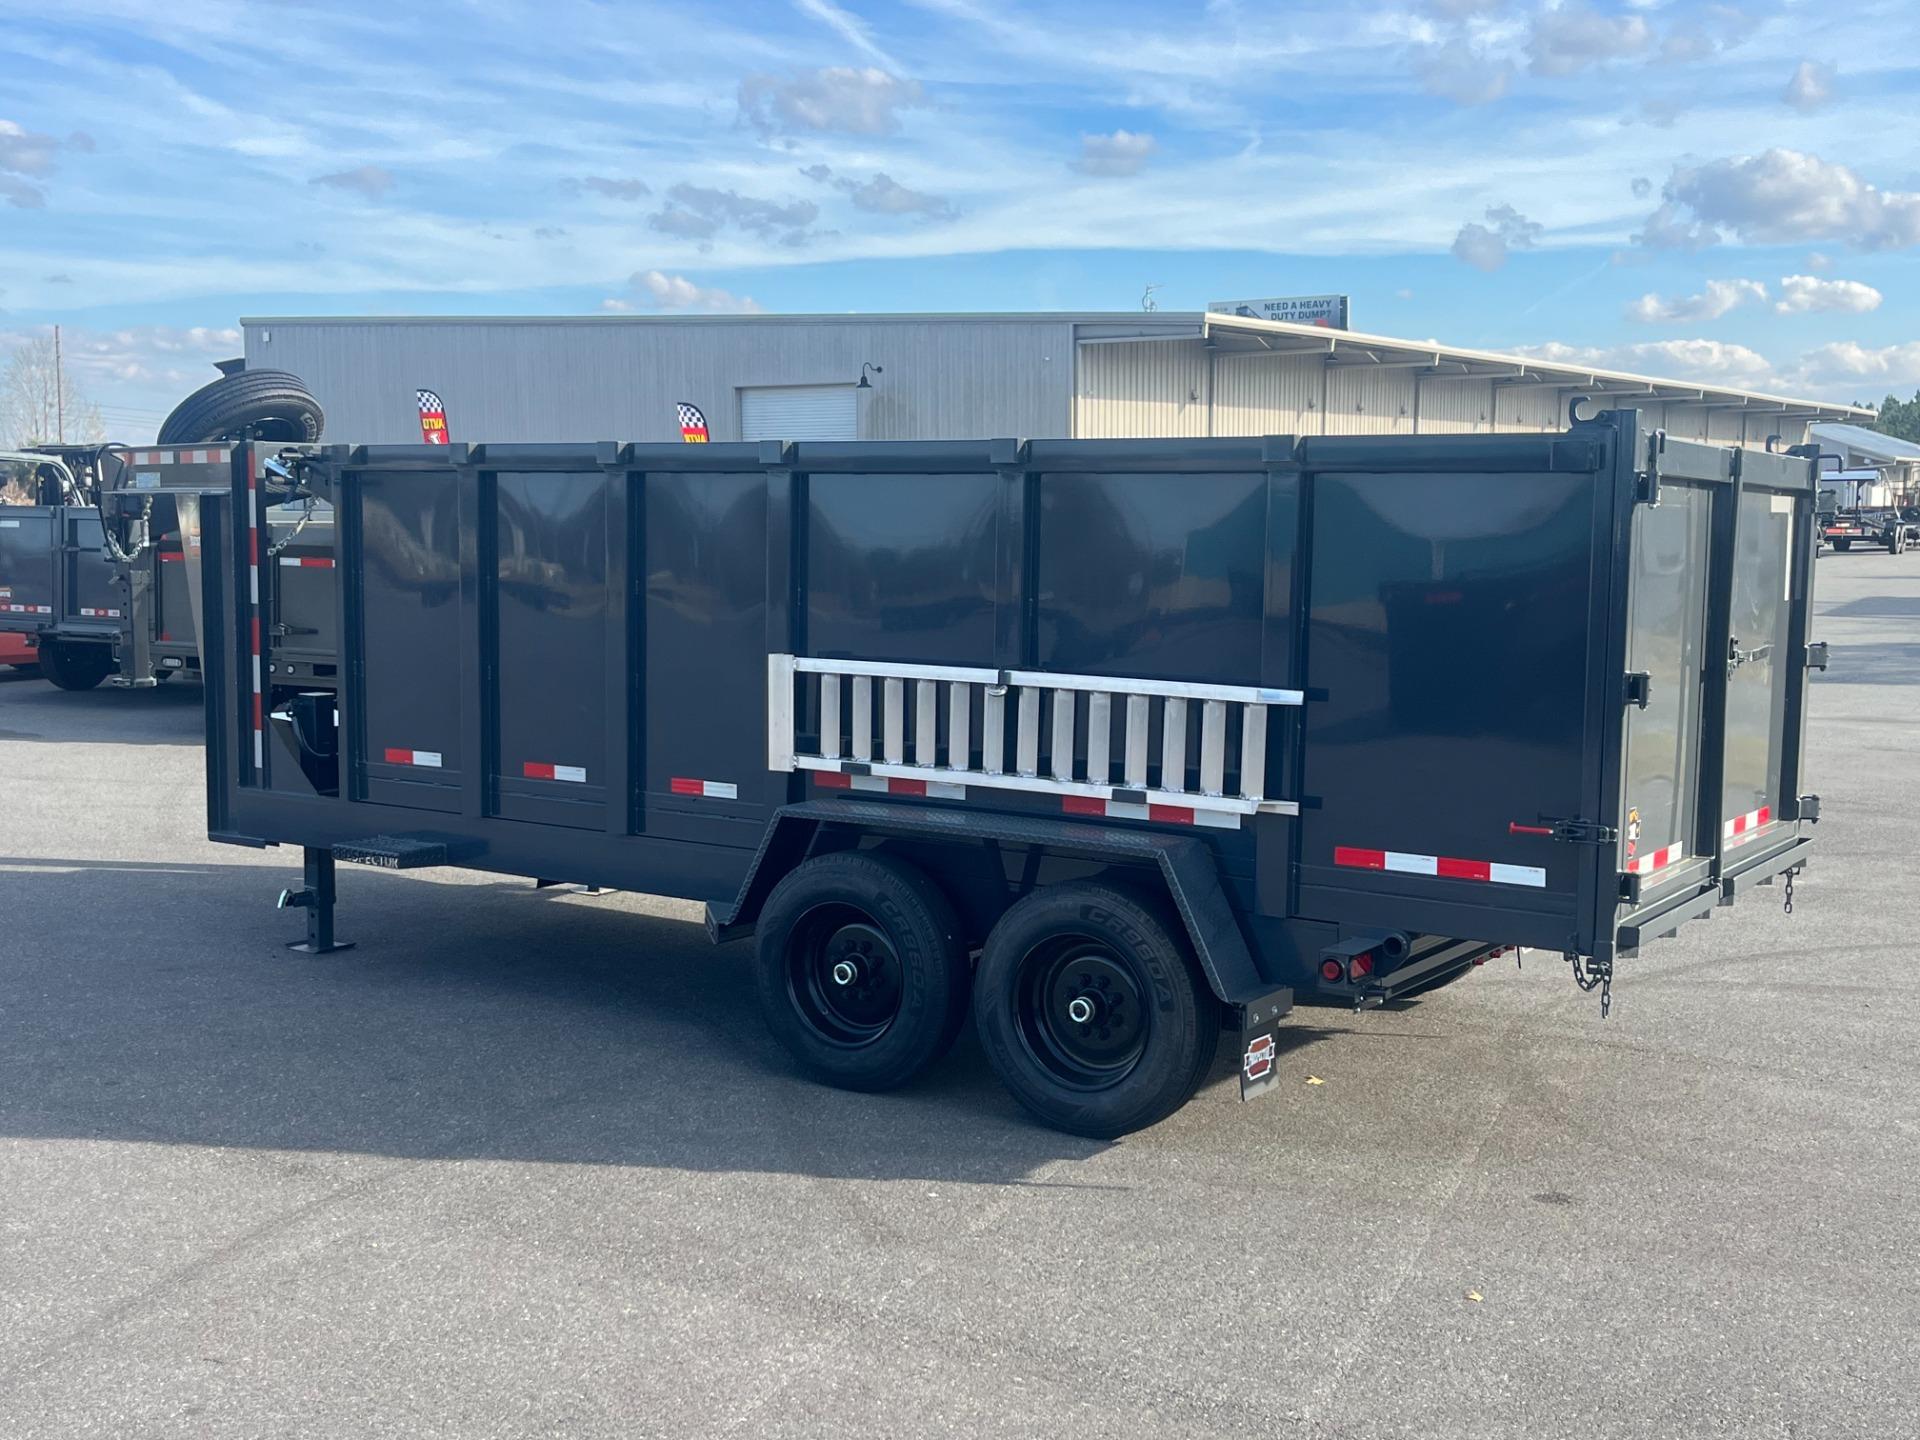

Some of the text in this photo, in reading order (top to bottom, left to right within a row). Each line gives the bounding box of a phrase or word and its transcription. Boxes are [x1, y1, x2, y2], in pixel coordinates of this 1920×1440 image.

[1264, 300, 1332, 311] NEED A HEAVY
[1270, 310, 1332, 321] DUTY DUMP?
[1087, 907, 1172, 1003] CR960A
